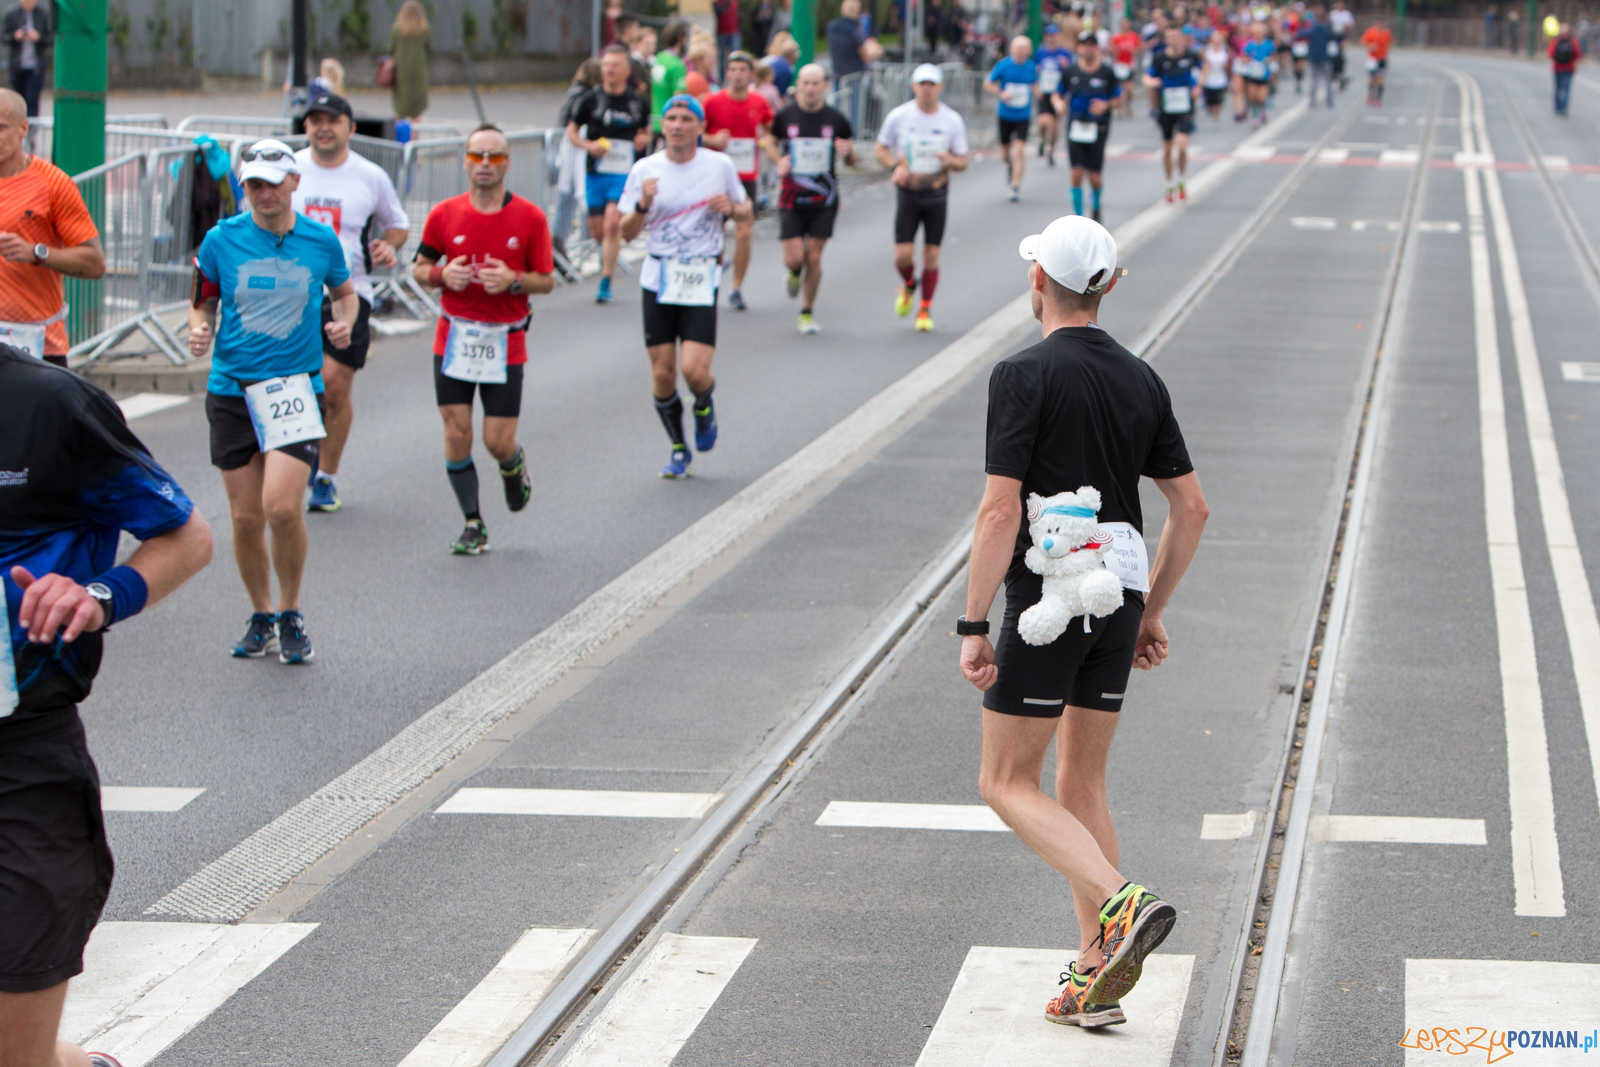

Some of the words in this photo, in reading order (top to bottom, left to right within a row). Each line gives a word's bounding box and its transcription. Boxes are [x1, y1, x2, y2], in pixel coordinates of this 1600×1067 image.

[674, 271, 704, 285] 7169
[461, 342, 495, 360] 3378
[270, 397, 304, 419] 220
